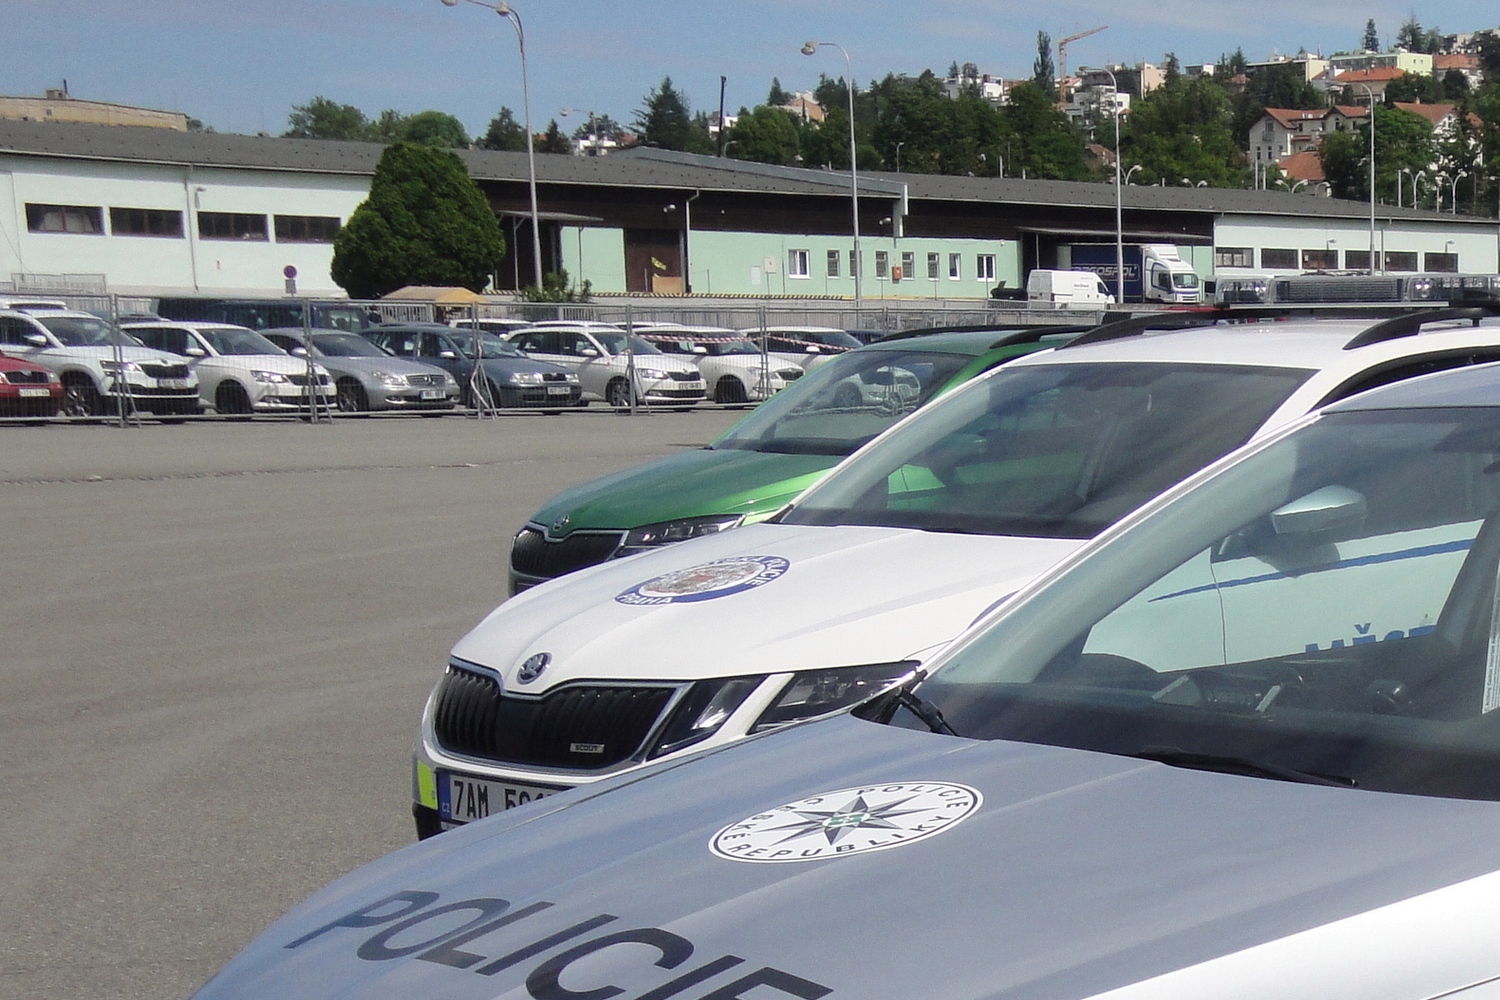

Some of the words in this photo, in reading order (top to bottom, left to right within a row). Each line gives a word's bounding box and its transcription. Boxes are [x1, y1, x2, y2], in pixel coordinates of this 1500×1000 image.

[617, 592, 673, 605] PRAHA
[575, 744, 598, 752] SCOUT
[454, 780, 489, 819] 7AM
[856, 783, 969, 809] POLICIE
[726, 815, 951, 859] REPUBLIKY
